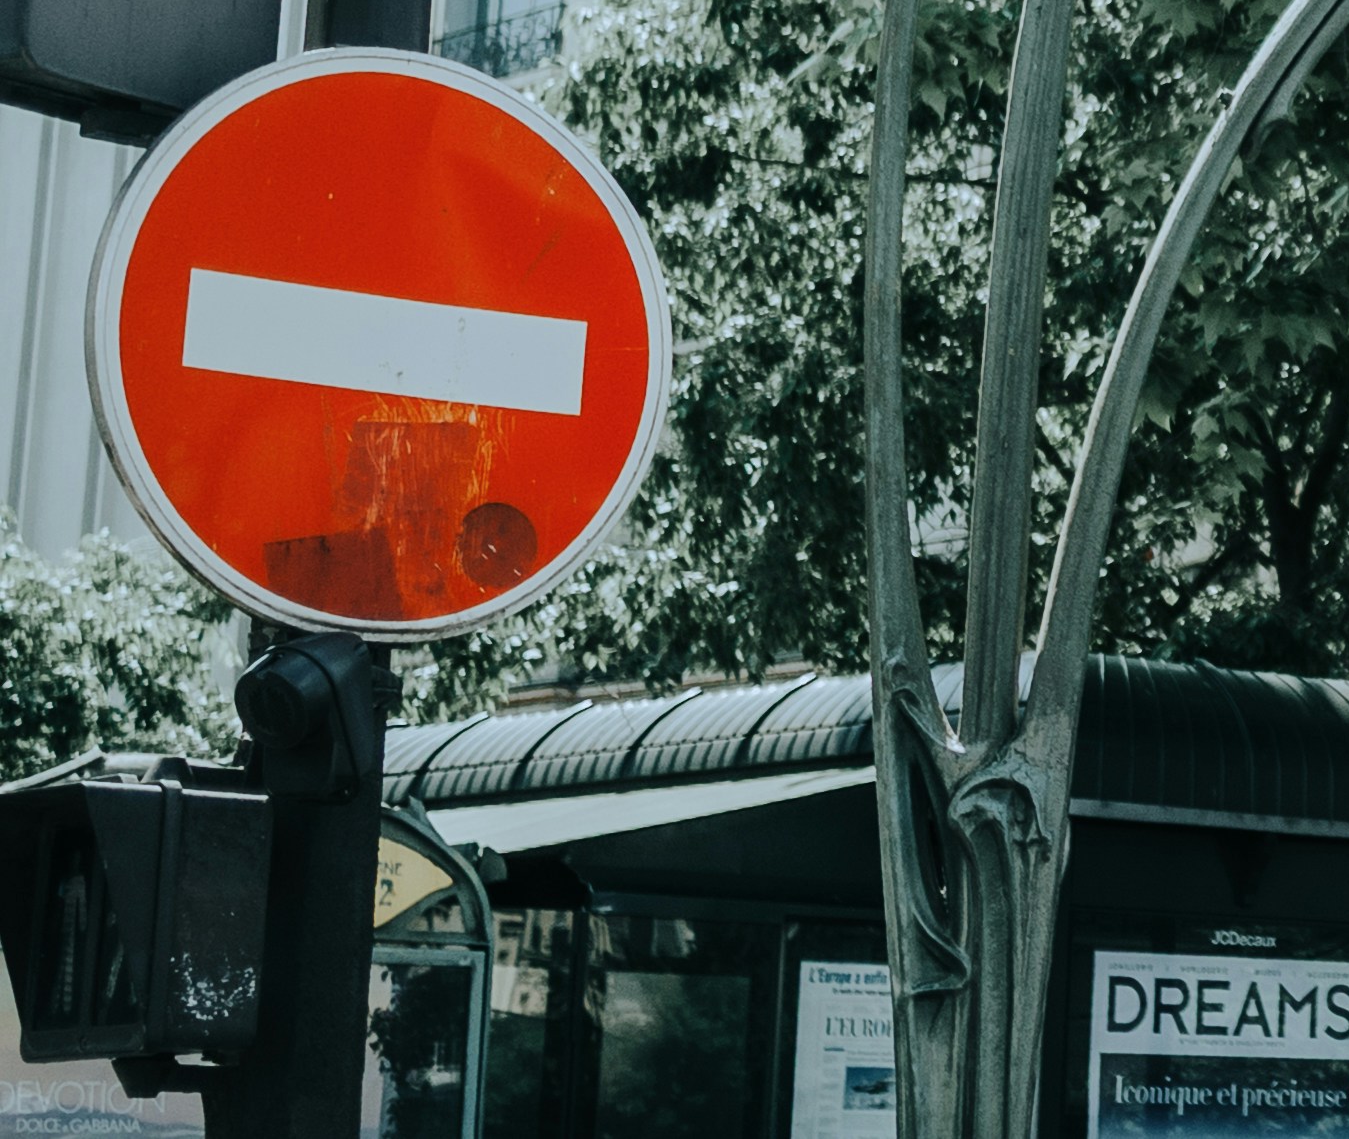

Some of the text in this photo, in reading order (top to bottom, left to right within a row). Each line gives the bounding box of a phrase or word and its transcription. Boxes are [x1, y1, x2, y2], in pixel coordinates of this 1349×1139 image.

[378, 878, 396, 907] 2
[1211, 930, 1277, 949] JCDecaux
[0, 1079, 167, 1114] DEVOTION
[1113, 1074, 1348, 1117] Iconique et précieuse
